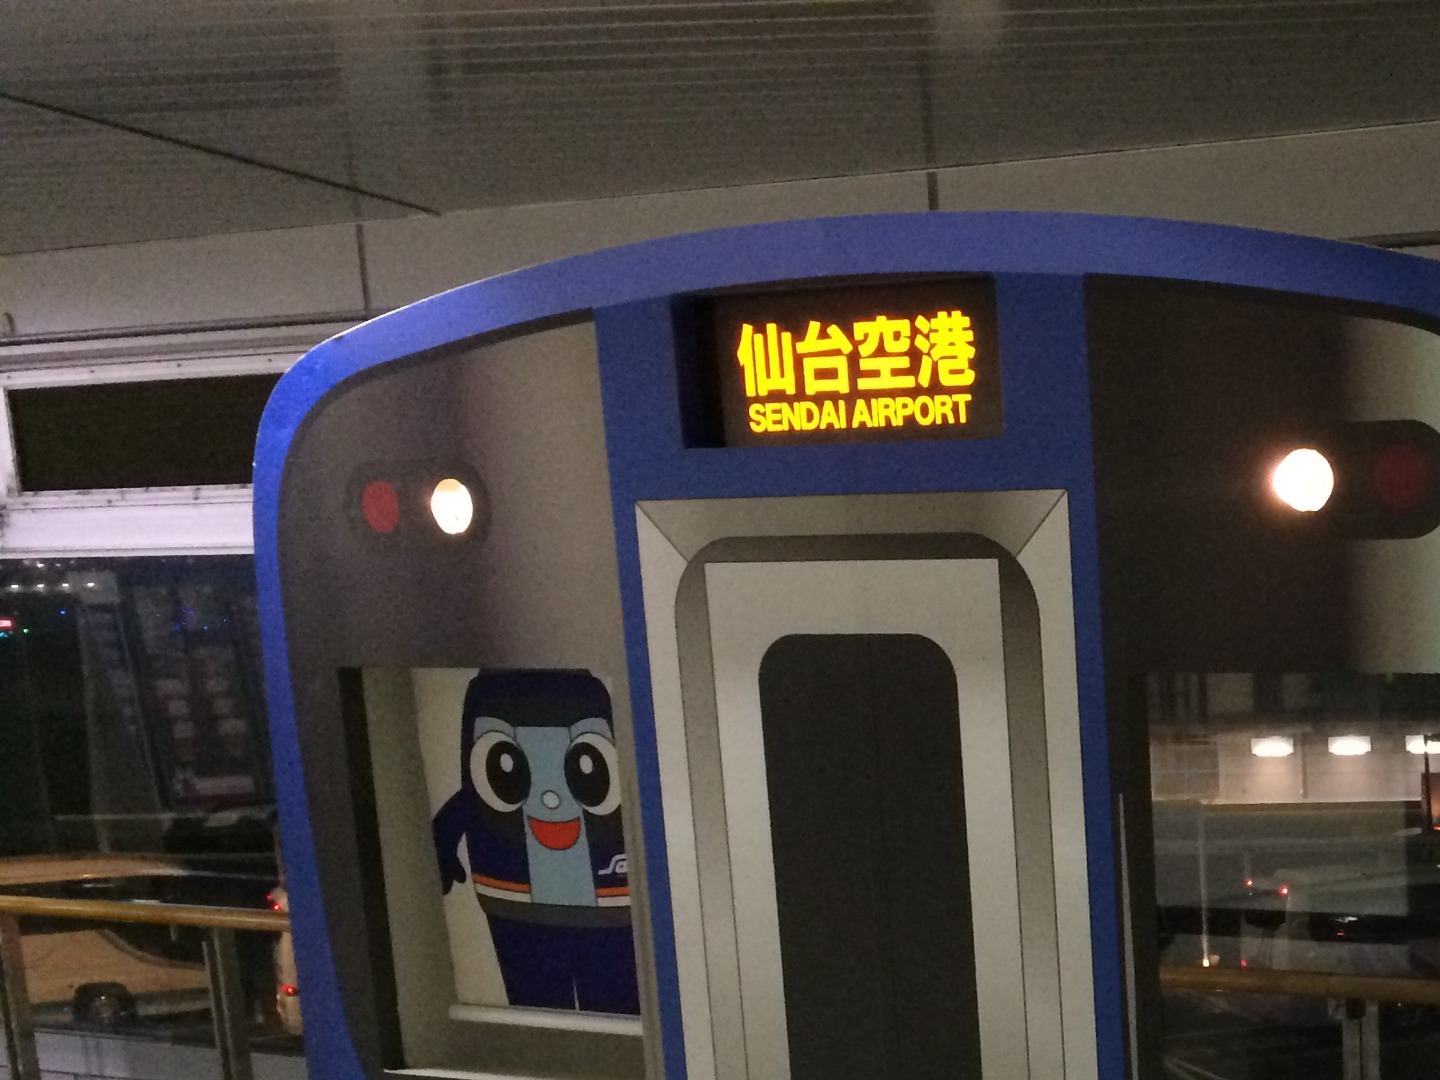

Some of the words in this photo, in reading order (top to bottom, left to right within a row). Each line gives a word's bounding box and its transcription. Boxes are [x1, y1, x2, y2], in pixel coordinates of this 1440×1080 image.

[737, 310, 976, 397] 仙台空港
[749, 400, 846, 433] SENDAI
[852, 394, 972, 428] AIRPORT
